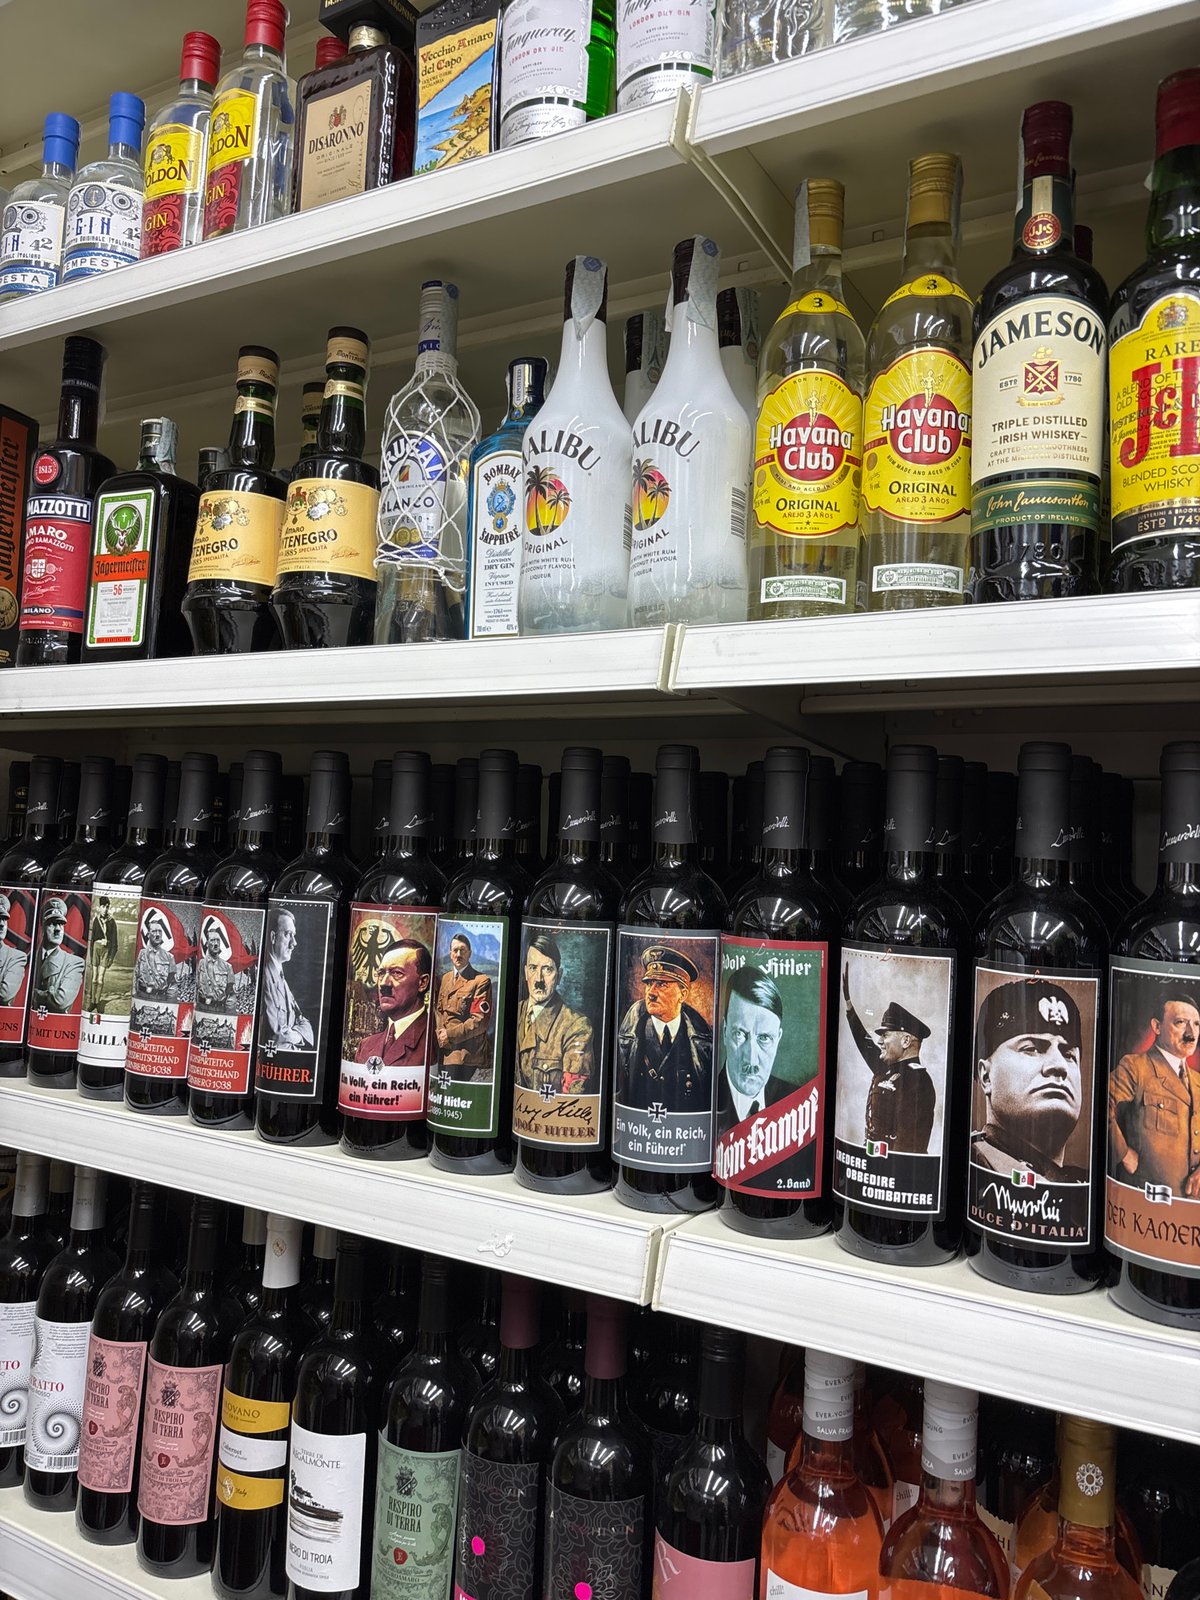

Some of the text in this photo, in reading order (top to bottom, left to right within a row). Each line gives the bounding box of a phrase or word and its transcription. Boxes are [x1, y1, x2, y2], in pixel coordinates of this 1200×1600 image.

[420, 31, 494, 64] Vecchio Amaro
[421, 55, 462, 77] del Capo
[308, 121, 365, 155] DISARONNO
[206, 183, 226, 206] GIN
[144, 213, 168, 232] GIN
[29, 237, 53, 252] 42
[927, 279, 938, 290] 3
[813, 298, 823, 308] 3
[978, 311, 1105, 369] JAMESON
[1144, 339, 1200, 363] RARE
[829, 379, 845, 393] CUBA
[1064, 375, 1082, 383] 1780
[1122, 372, 1172, 398] BLEND OF
[1116, 395, 1133, 412] OLD
[881, 404, 971, 433] Havana
[992, 415, 1088, 433] TRIPLE DISTILLED
[769, 422, 854, 451] Havana
[897, 428, 951, 455] Club
[999, 430, 1081, 445] IRISH WHISKEY
[522, 430, 602, 472] ALIBU
[783, 446, 836, 472] Club
[989, 446, 1021, 458] CRAFTED
[996, 456, 1010, 465] THE
[1052, 452, 1090, 463] DISTILLERY
[38, 465, 53, 474] 1815
[483, 463, 522, 486] BOMBAY
[886, 454, 897, 468] RUM
[896, 463, 912, 474] MADE
[912, 469, 926, 477] AND
[927, 468, 944, 477] AGED
[950, 455, 963, 469] CUBA
[1122, 467, 1167, 488] BLENDED
[1143, 477, 1194, 493] WHISKY
[888, 480, 958, 497] ORIGINAL
[381, 496, 435, 514] BLANCO
[776, 497, 841, 513] ORIGINAL
[895, 494, 950, 505] AÑEJO 3 AÑOS
[782, 509, 834, 520] AÑEJO 3 AÑOS
[995, 514, 1032, 525] PRODUCT
[1047, 514, 1080, 522] IRELAND
[35, 536, 75, 553] RAMAZZOTTI
[478, 525, 522, 546] SAPPHIRE
[485, 549, 514, 559] Distilled
[524, 536, 569, 554] ORIGINAL
[643, 550, 660, 558] WHITE
[1009, 541, 1063, 561] 1780
[94, 557, 147, 577] Jägermeister
[484, 562, 515, 571] DRY GIN
[650, 555, 678, 564] FLAVOUR
[525, 564, 547, 574] COCONUT
[529, 573, 552, 581] LIQUEUR
[112, 583, 123, 597] 56
[758, 956, 812, 979] Hitler
[36, 1027, 77, 1040] MIT UNS
[81, 1031, 128, 1047] BALILLA
[152, 1065, 172, 1075] 1938
[212, 1080, 232, 1090] 1938
[349, 1074, 369, 1091] Volk,
[371, 1078, 388, 1090] ein
[390, 1079, 421, 1092] Reich,
[348, 1091, 400, 1107] ein Führer!
[443, 1095, 473, 1109] Hitler
[544, 1124, 596, 1138] HITLER
[616, 1117, 707, 1141] Ein Volk, ein Reich,
[747, 1086, 820, 1165] Kampf
[628, 1140, 684, 1156] ein Führer!
[846, 1167, 896, 1189] OBBEDIRE
[861, 1185, 933, 1205] COMBATTERE
[971, 1204, 1086, 1238] DUCE D'ITALIA
[1107, 1200, 1127, 1229] DER
[87, 1378, 111, 1396] RESPIRO
[90, 1394, 109, 1409] TERRA
[153, 1407, 185, 1426] RESPIRO
[152, 1420, 184, 1439] DI TERRA
[816, 1425, 837, 1436] SALVA
[388, 1496, 422, 1518] RESPIRO
[386, 1510, 422, 1533] DI TERRA
[289, 1542, 333, 1565] NERO DI TROIA
